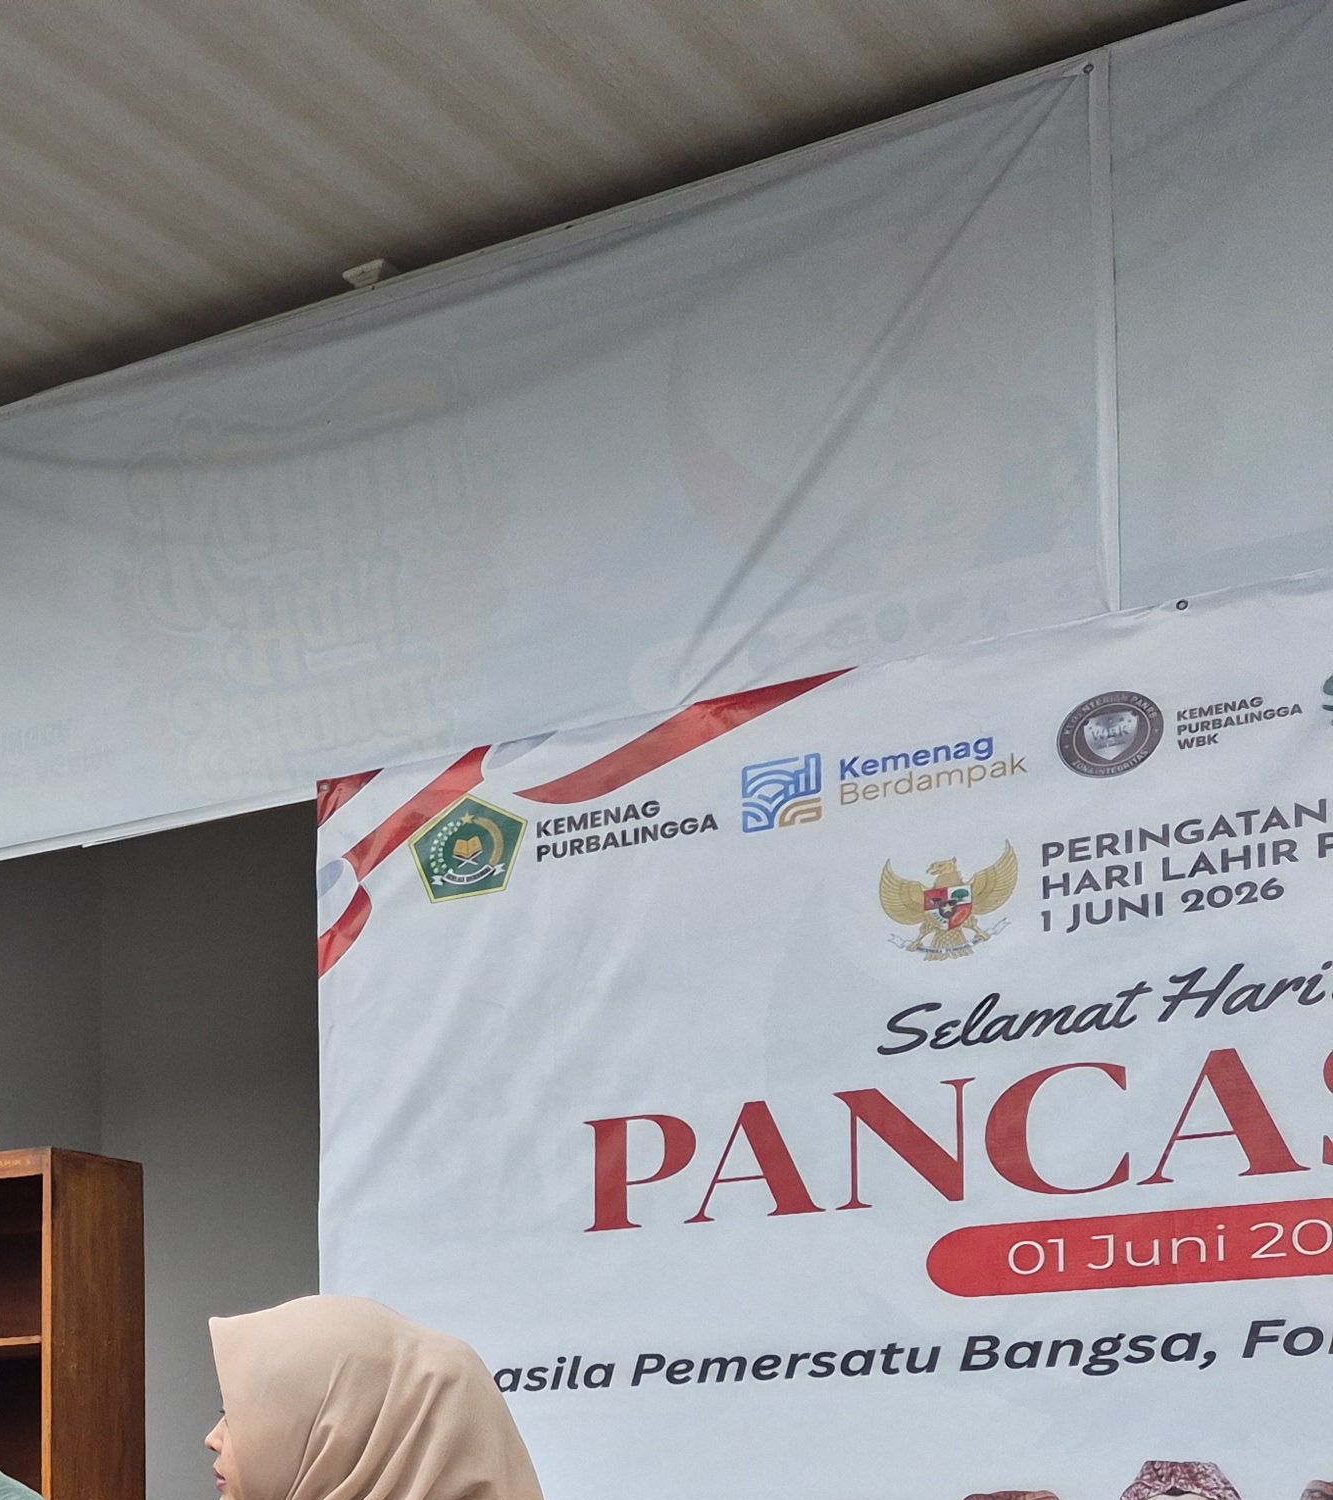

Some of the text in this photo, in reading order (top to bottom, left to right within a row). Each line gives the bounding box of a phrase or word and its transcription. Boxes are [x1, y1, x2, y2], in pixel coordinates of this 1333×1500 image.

[1090, 723, 1130, 742] WBK
[1176, 696, 1263, 722] KEMENAG
[1176, 703, 1303, 736] PURBALINGGA
[840, 737, 994, 781] Kemenag
[1176, 733, 1219, 750] WBK
[840, 753, 1028, 805] Berdampak
[536, 800, 660, 839] KEMENAG
[536, 814, 719, 862] PURBALINGGA
[1041, 798, 1327, 867] PERINGATAN
[1042, 861, 1143, 900] HARI
[1162, 838, 1299, 882] LAHIR
[1041, 877, 1284, 933] 1 JUNI 2026
[877, 960, 1333, 1056] Selamat Hari
[583, 1047, 1333, 1232] PANCA
[1007, 1218, 1333, 1275] 01 Juni 20
[493, 1318, 1333, 1393] asila Pemersatu Bangsa, Fo
